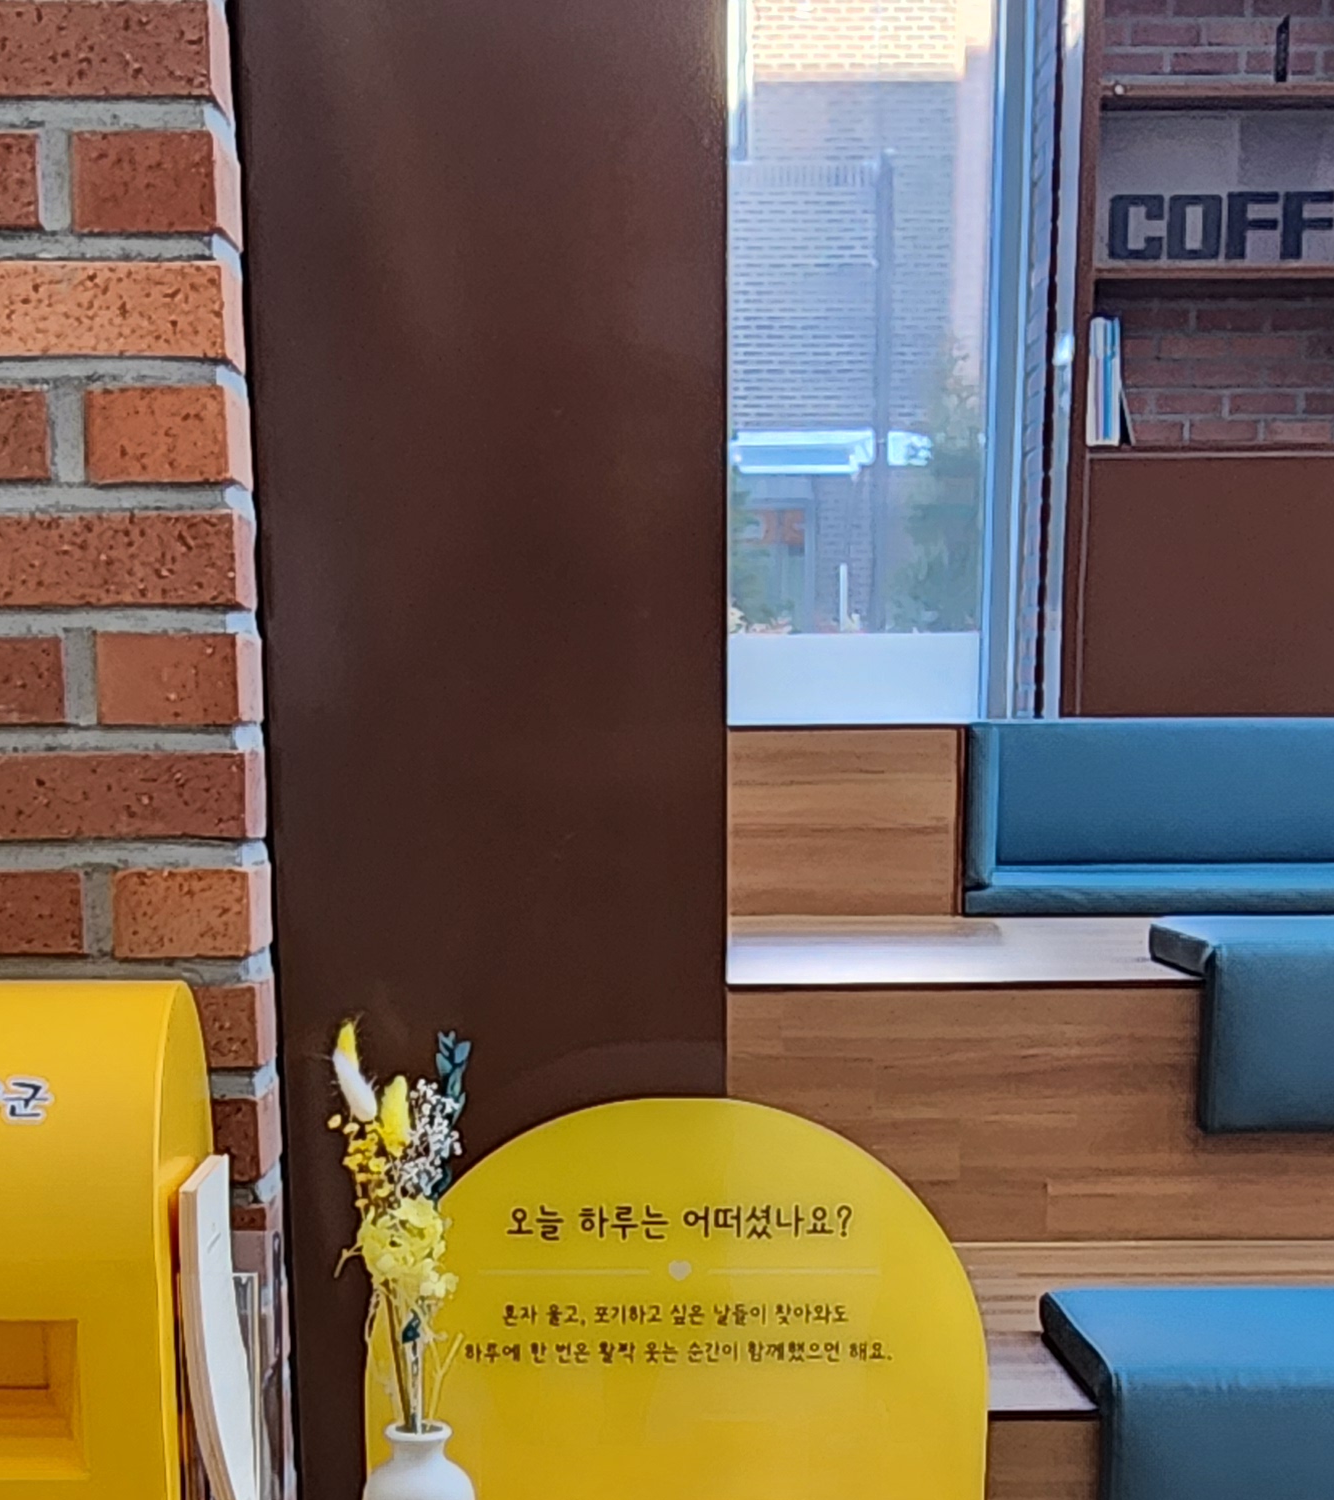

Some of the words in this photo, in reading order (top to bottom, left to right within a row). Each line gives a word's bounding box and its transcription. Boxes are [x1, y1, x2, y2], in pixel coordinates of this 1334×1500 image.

[505, 1205, 565, 1240] 오늘
[578, 1205, 670, 1240] 하루는
[682, 1204, 855, 1240] 어떠셨나요?
[503, 1304, 537, 1327] 혼자
[594, 1305, 662, 1325] 포기하고
[670, 1304, 705, 1326] 싶은
[714, 1304, 766, 1326] 날들이
[776, 1304, 849, 1326] 찾아와도
[465, 1342, 520, 1363] 하루에
[530, 1342, 546, 1364] 한
[555, 1342, 590, 1364] 번은
[644, 1342, 678, 1363] 웃는
[687, 1342, 738, 1363] 순간이
[748, 1341, 840, 1363] 함께했으면
[849, 1342, 892, 1361] 해요.
